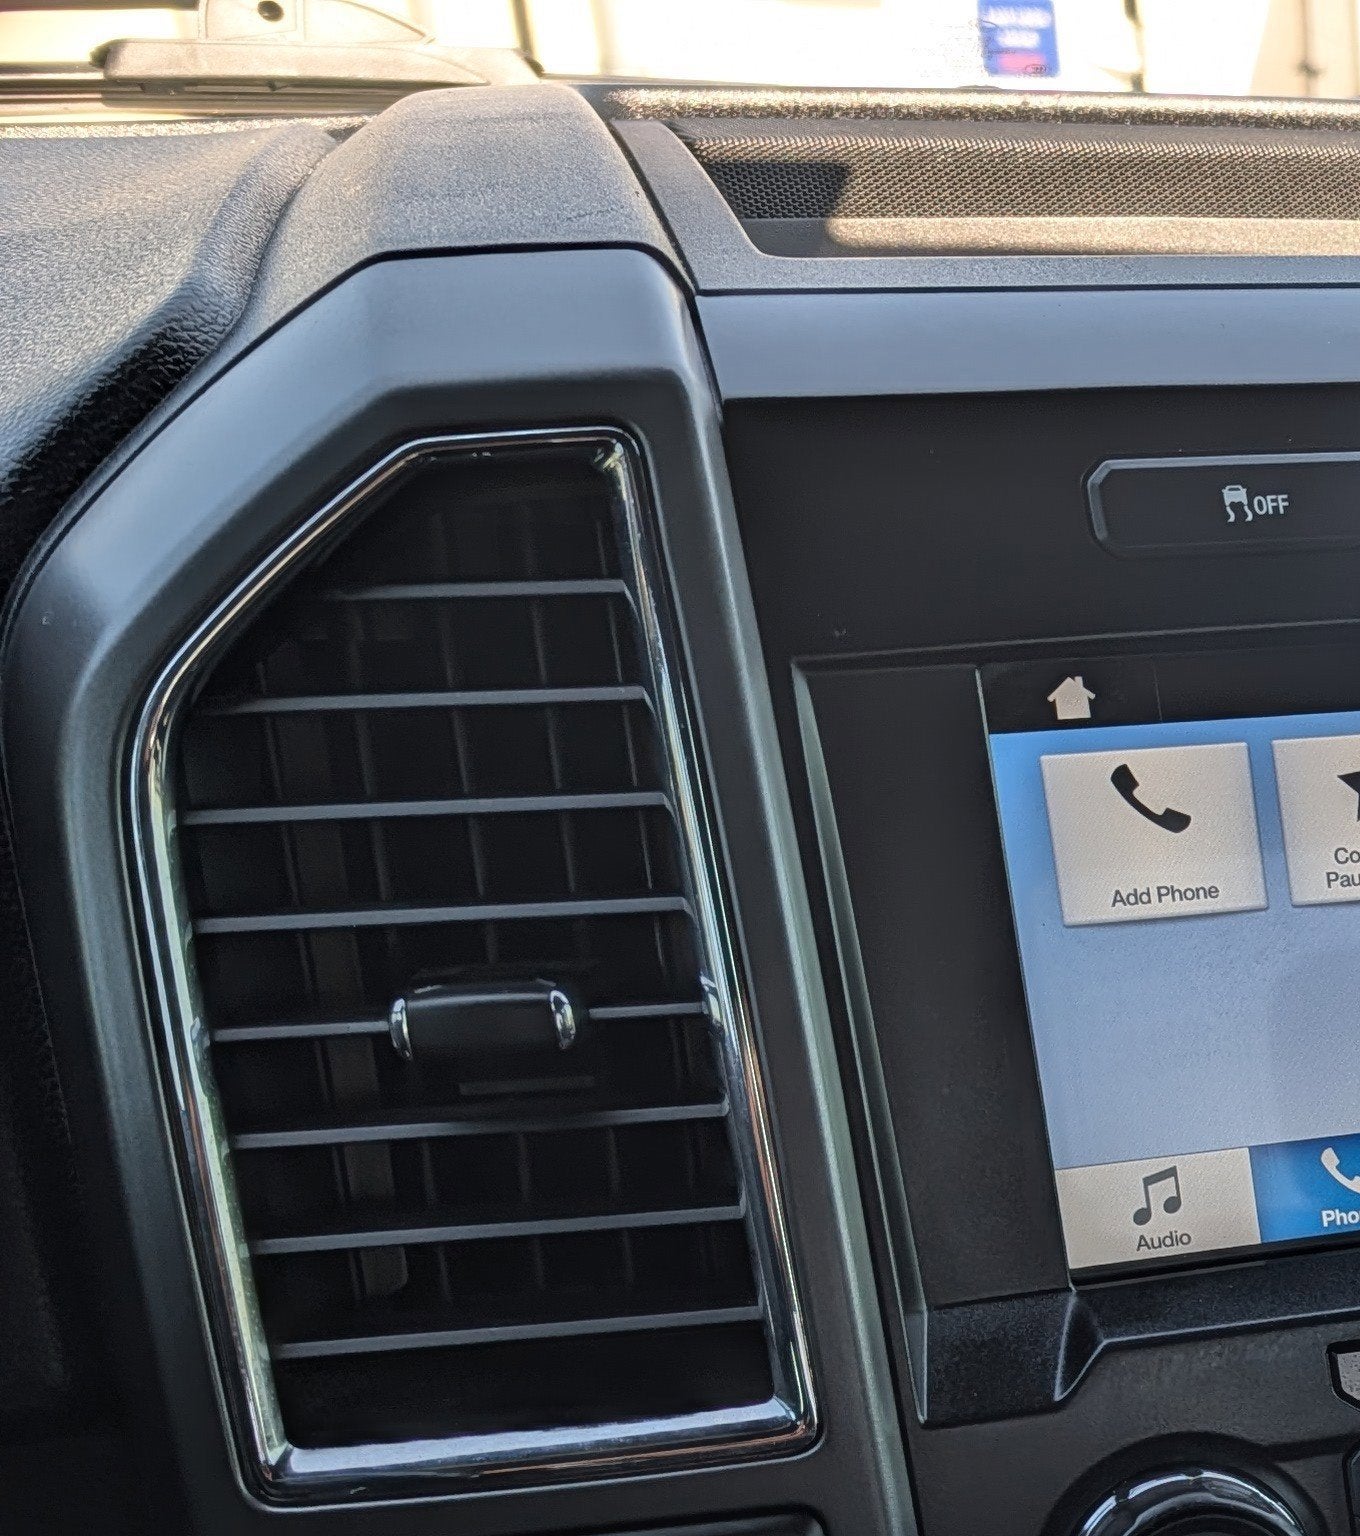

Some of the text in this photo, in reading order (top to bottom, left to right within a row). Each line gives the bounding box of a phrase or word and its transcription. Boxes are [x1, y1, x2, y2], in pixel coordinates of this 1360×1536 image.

[1254, 494, 1290, 515] OFF
[1110, 884, 1220, 907] Add Phone
[1136, 1230, 1192, 1252] Audio
